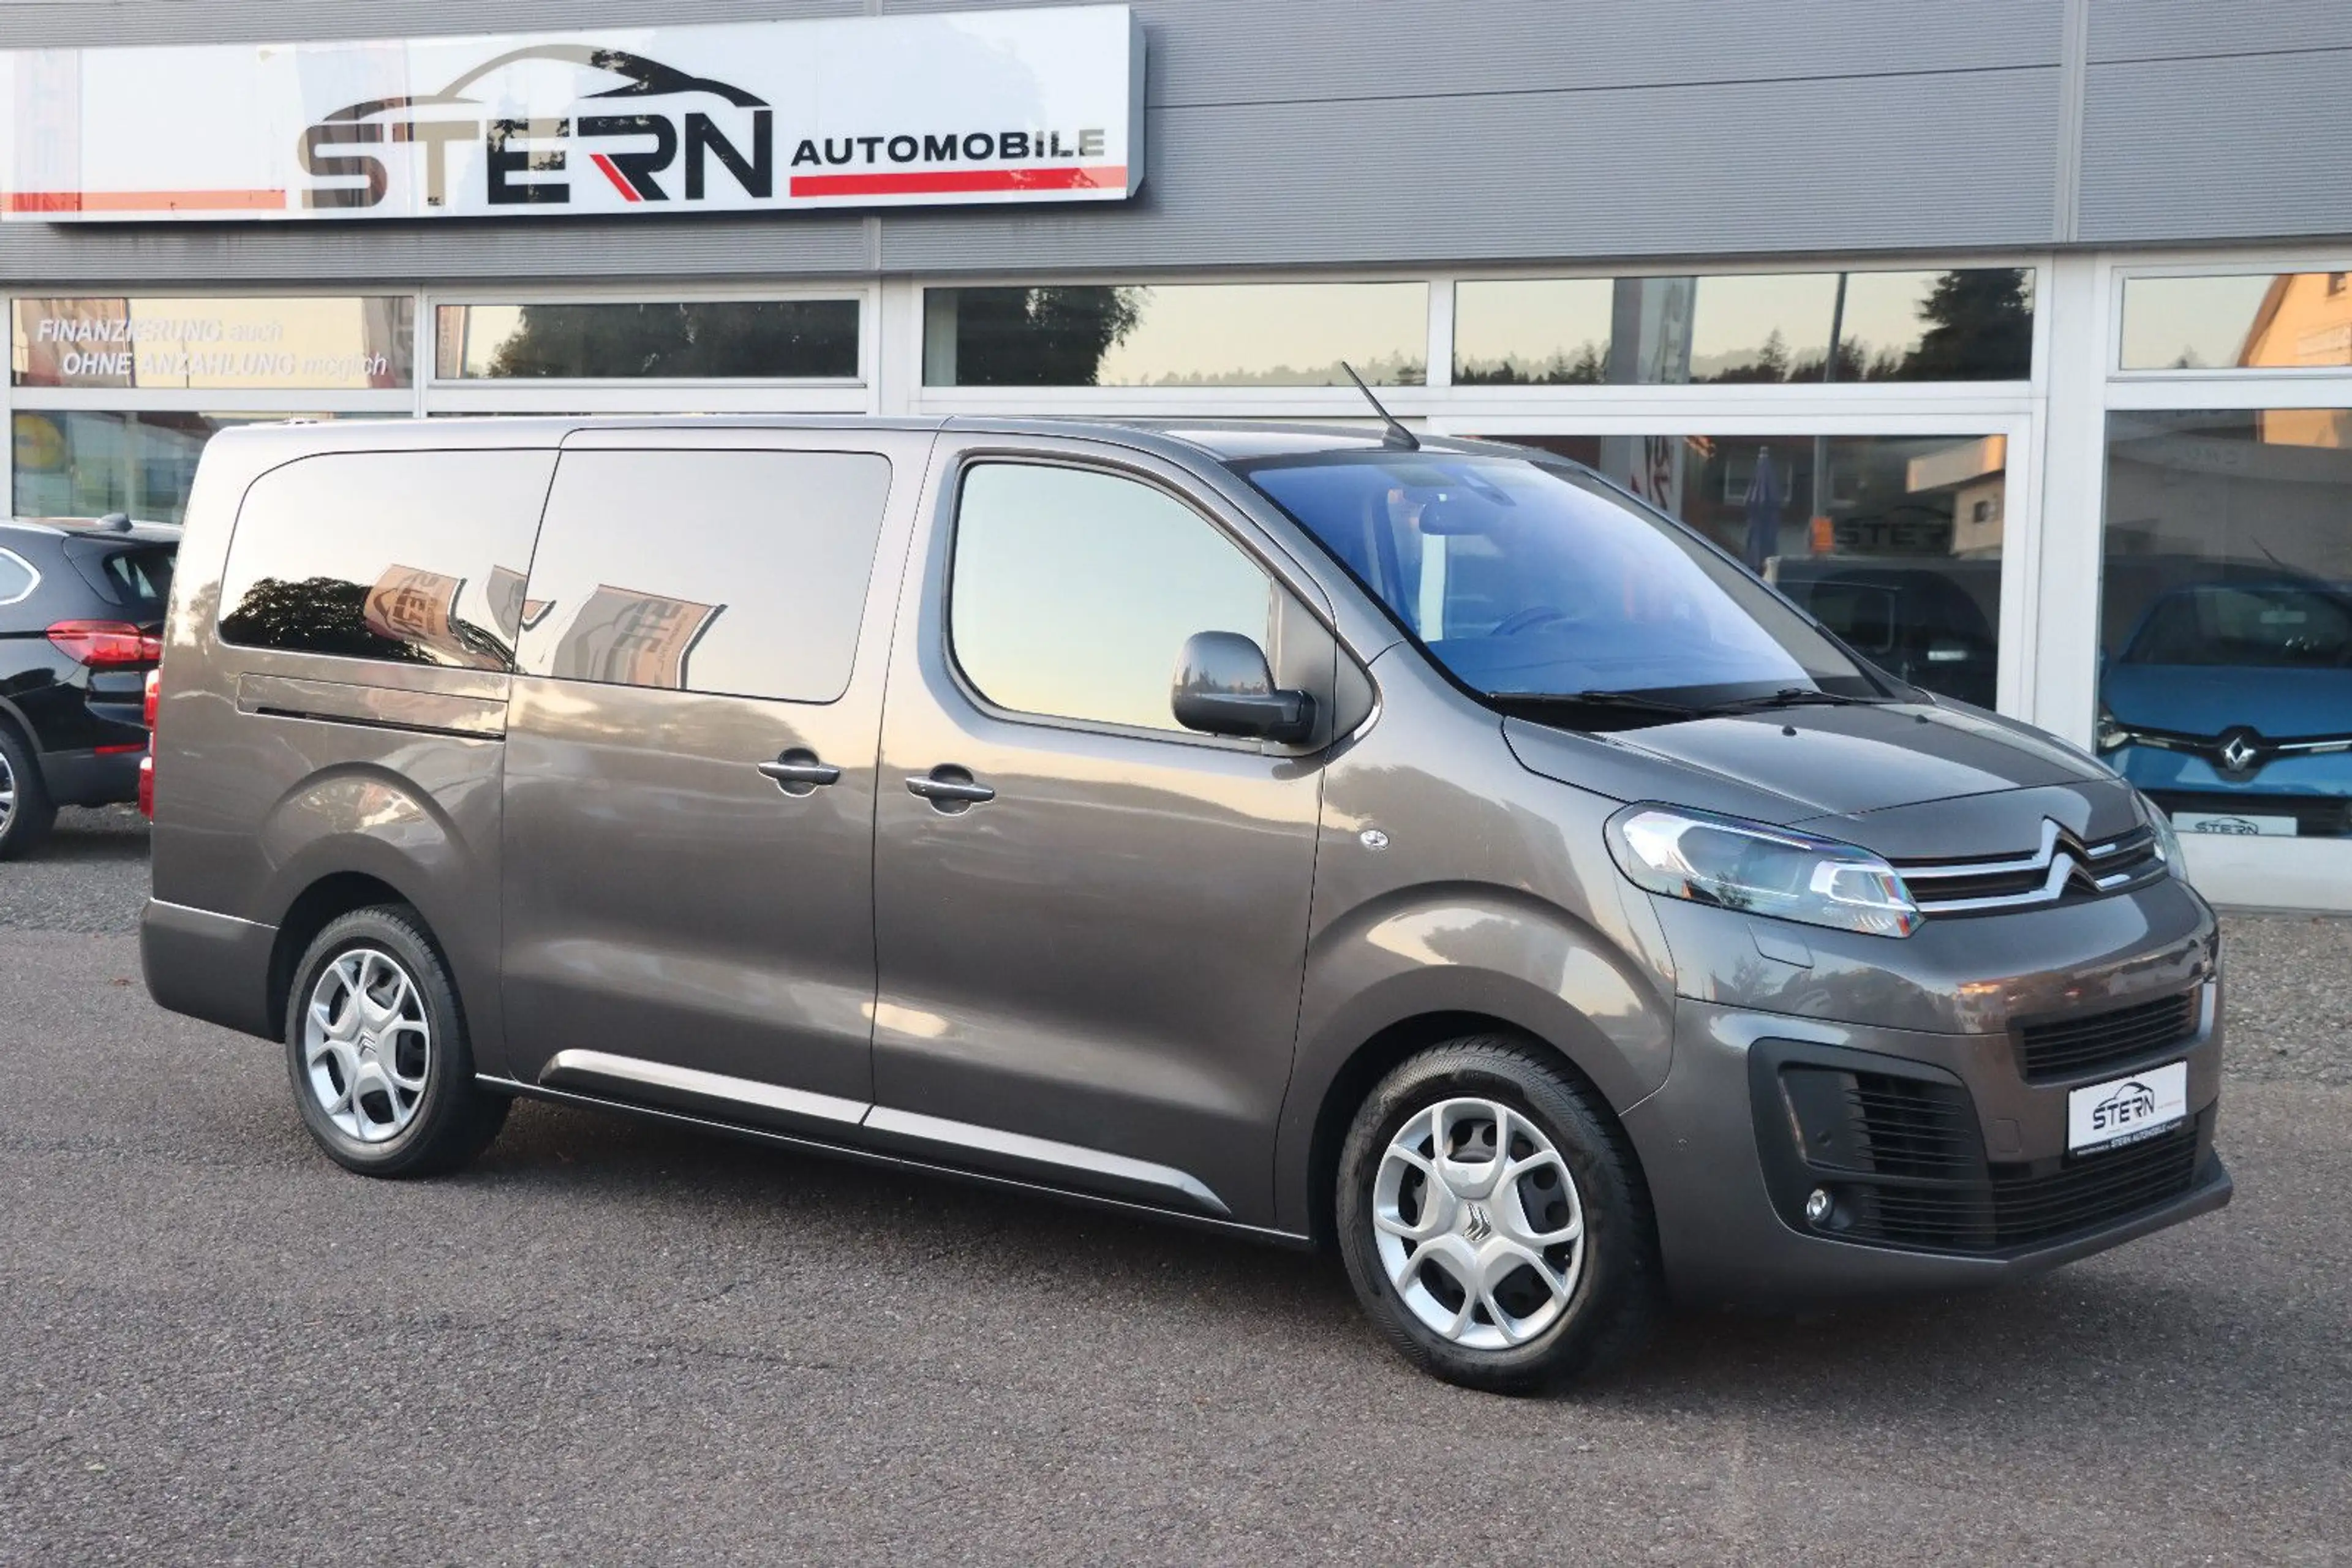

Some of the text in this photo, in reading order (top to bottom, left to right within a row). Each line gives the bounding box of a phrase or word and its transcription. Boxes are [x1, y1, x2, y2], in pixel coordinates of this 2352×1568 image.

[298, 110, 1105, 209] STERN AUTOMOBILE
[37, 319, 284, 342] FINANZIERUNG auch
[63, 352, 133, 375] OHNE
[140, 352, 296, 375] ANZAHLUNG
[2195, 823, 2259, 835] STERN
[2093, 1094, 2155, 1130] STERN
